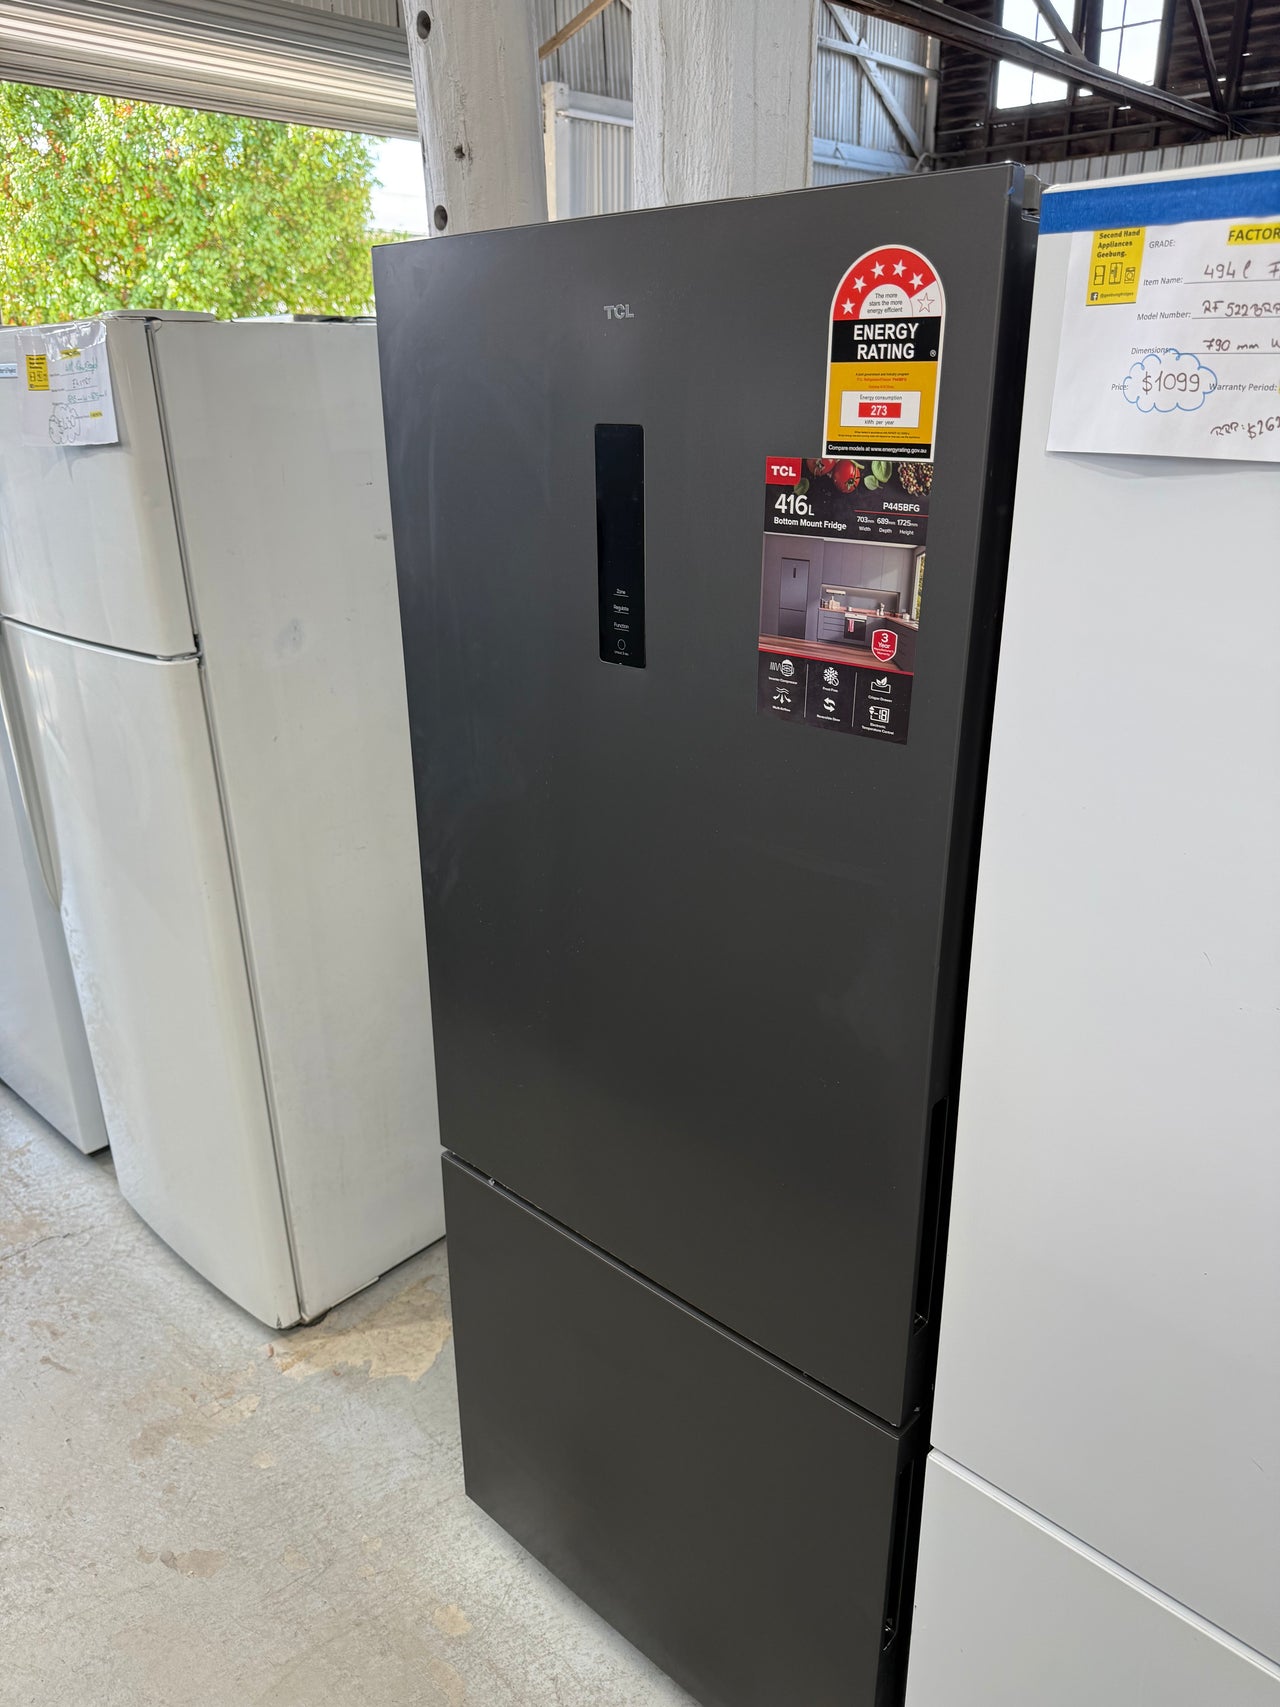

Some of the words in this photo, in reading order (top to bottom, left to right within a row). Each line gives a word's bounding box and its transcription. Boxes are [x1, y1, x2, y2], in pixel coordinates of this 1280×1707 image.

[1099, 231, 1123, 239] Second
[1123, 229, 1141, 238] Hand
[1098, 240, 1133, 250] Appliances
[1149, 239, 1176, 249] GRADE:
[1143, 278, 1159, 286] Item
[1160, 276, 1183, 285] Name:
[1203, 261, 1236, 279] 494
[604, 304, 634, 320] TCL
[1137, 312, 1158, 320] Model
[1159, 311, 1191, 319] Number:
[854, 322, 919, 340] ENERGY
[1202, 338, 1231, 351] 790
[857, 343, 914, 360] RATING
[1111, 383, 1129, 391] Price:
[1142, 371, 1200, 395] $1099
[1209, 383, 1247, 392] Warranty
[1248, 383, 1278, 391] Period:
[870, 405, 888, 416] 273
[828, 444, 848, 452] Compare
[771, 466, 796, 477] TCL
[774, 494, 815, 516] 416L
[883, 502, 920, 512] P445BFG
[774, 516, 798, 526] Bottom
[800, 518, 822, 528] Mount
[824, 521, 847, 531] Fridge
[881, 632, 888, 643] 3
